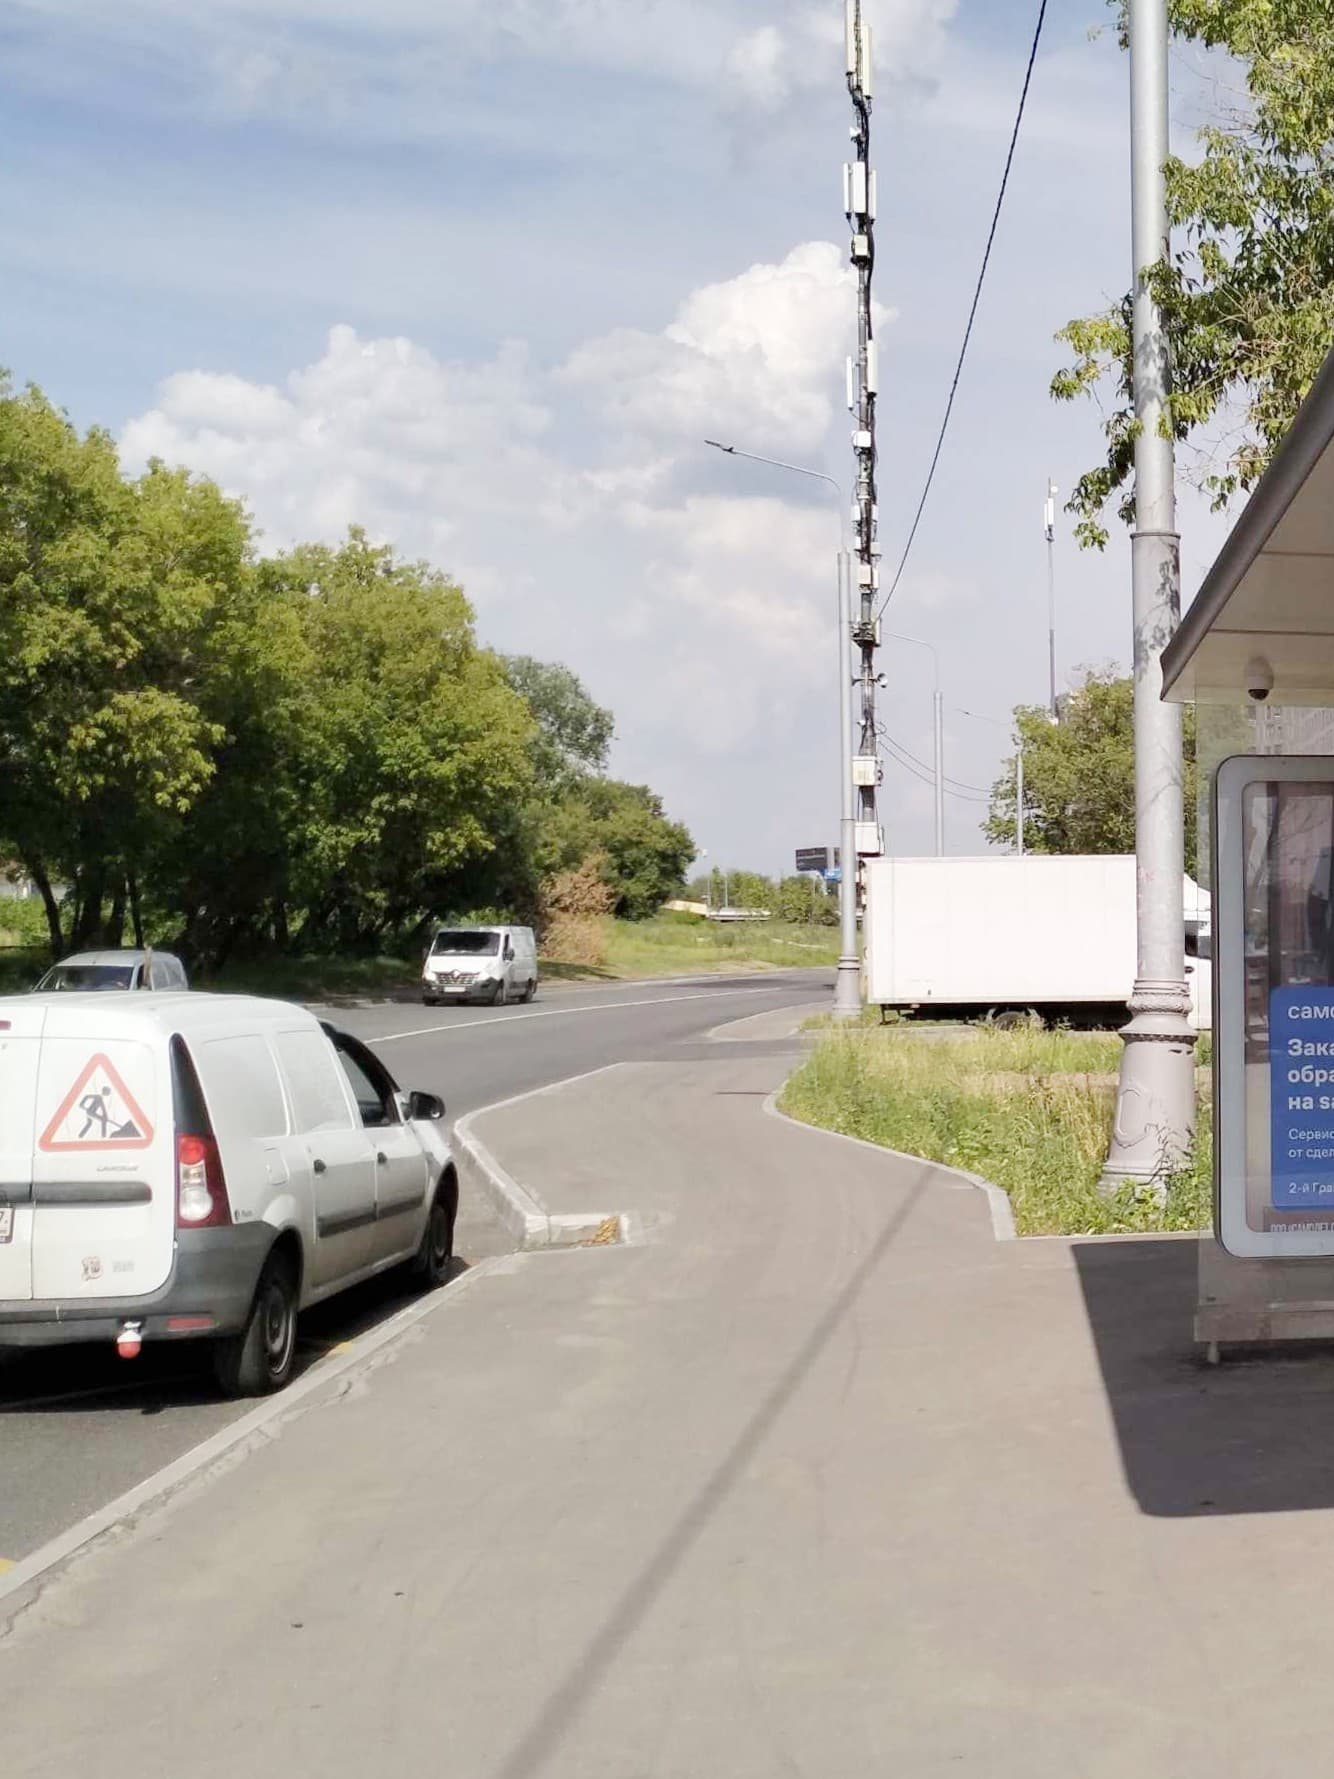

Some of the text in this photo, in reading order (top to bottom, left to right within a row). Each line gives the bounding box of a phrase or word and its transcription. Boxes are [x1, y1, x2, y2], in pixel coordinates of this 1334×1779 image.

[1288, 1095, 1314, 1110] на
[1288, 1148, 1303, 1159] от
[1288, 1181, 1310, 1195] 2-й
